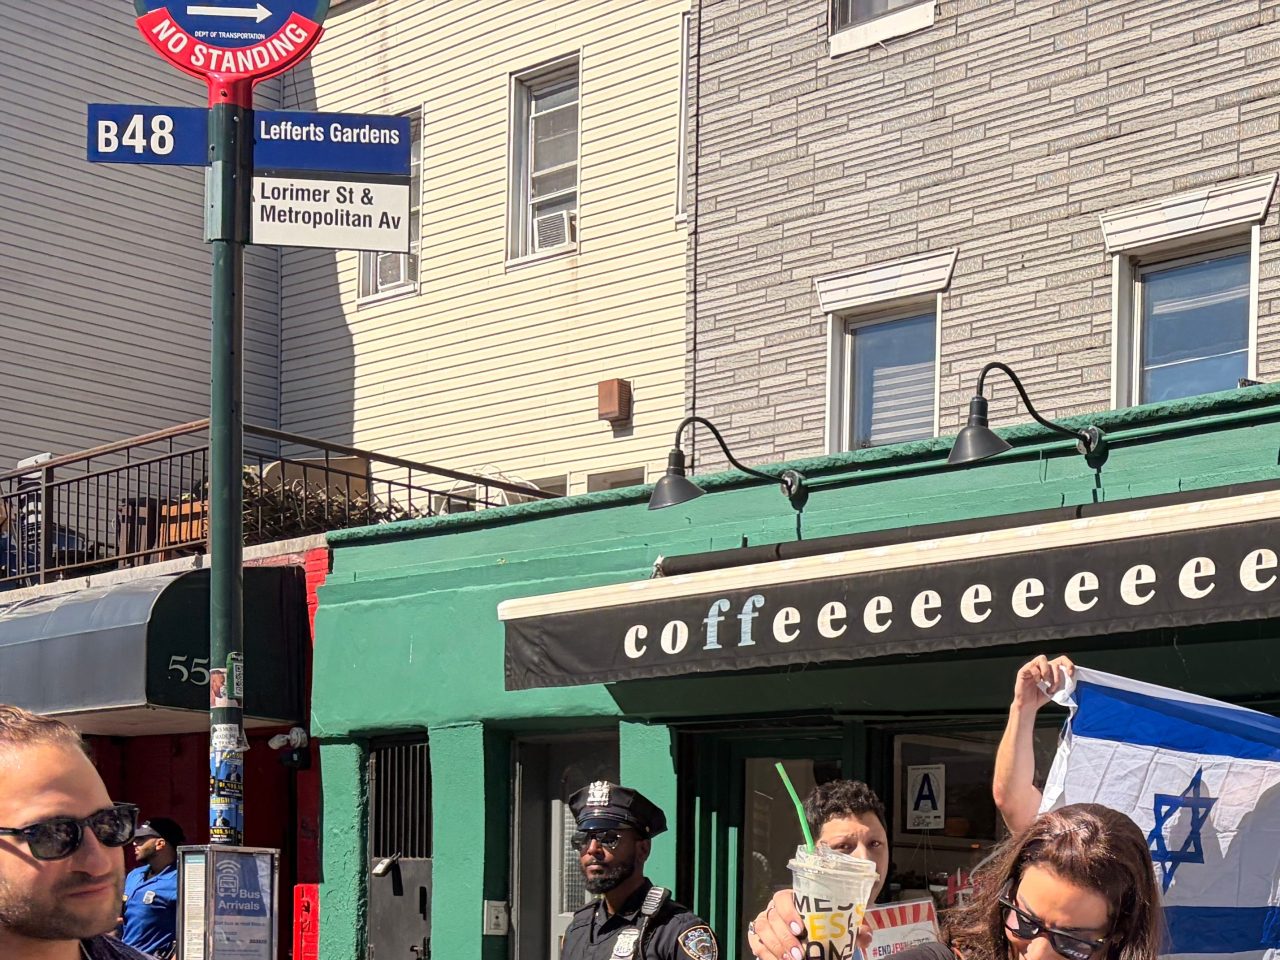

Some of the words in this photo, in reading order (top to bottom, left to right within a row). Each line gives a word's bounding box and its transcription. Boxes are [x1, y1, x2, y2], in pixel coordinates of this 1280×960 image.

[152, 18, 188, 54] NO
[190, 23, 308, 73] STANDING
[194, 30, 209, 38] DEPT
[218, 31, 266, 40] TRANSPORTATION
[97, 113, 175, 156] B48
[260, 120, 325, 142] Lefferts
[329, 122, 400, 145] Gardens
[260, 182, 330, 203] Lorimer
[335, 185, 354, 205] St
[360, 187, 374, 206] &
[260, 205, 373, 229] Metropolitan
[377, 212, 402, 231] Av
[912, 773, 938, 811] A
[217, 899, 260, 911] Arrivals
[239, 889, 260, 899] Bus
